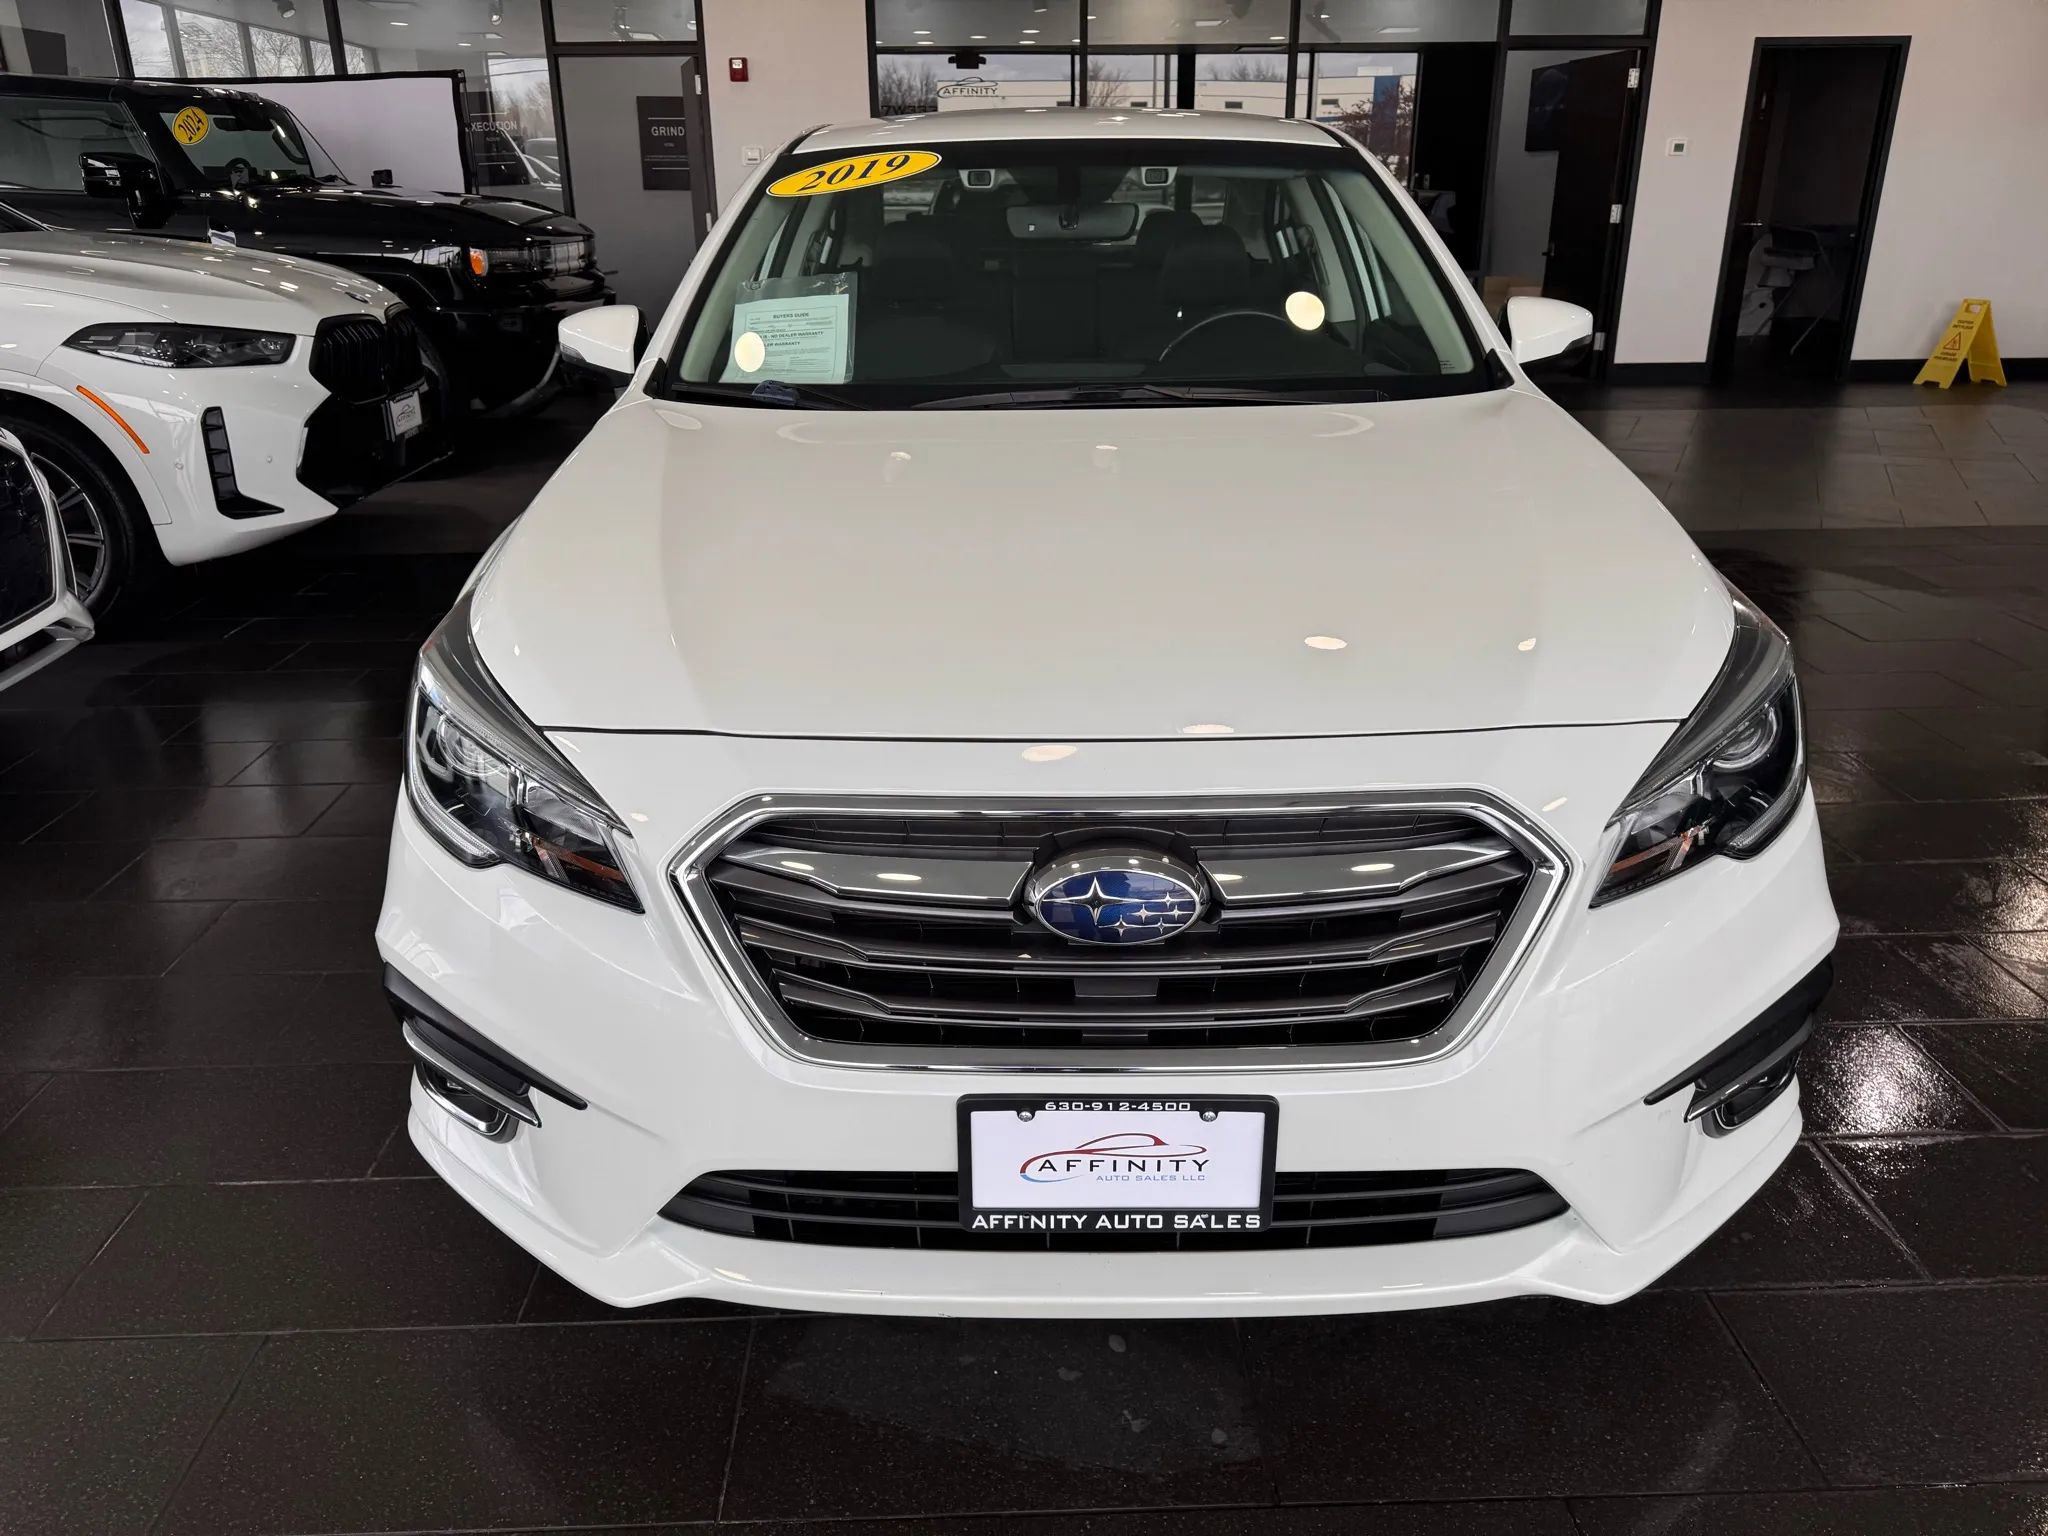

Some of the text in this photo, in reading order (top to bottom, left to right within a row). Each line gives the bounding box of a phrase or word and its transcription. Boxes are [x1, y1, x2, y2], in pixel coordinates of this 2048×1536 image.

[943, 87, 998, 96] AFFINITY
[178, 108, 205, 142] 2024
[651, 126, 685, 137] GRIND
[796, 154, 911, 193] 2019
[1045, 1102, 1191, 1112] 630-912-4500
[1038, 1159, 1210, 1172] AFFINITY
[1096, 1174, 1206, 1182] AUTO SALES LLC
[972, 1214, 1261, 1230] AFFINITY AUTO SALES
